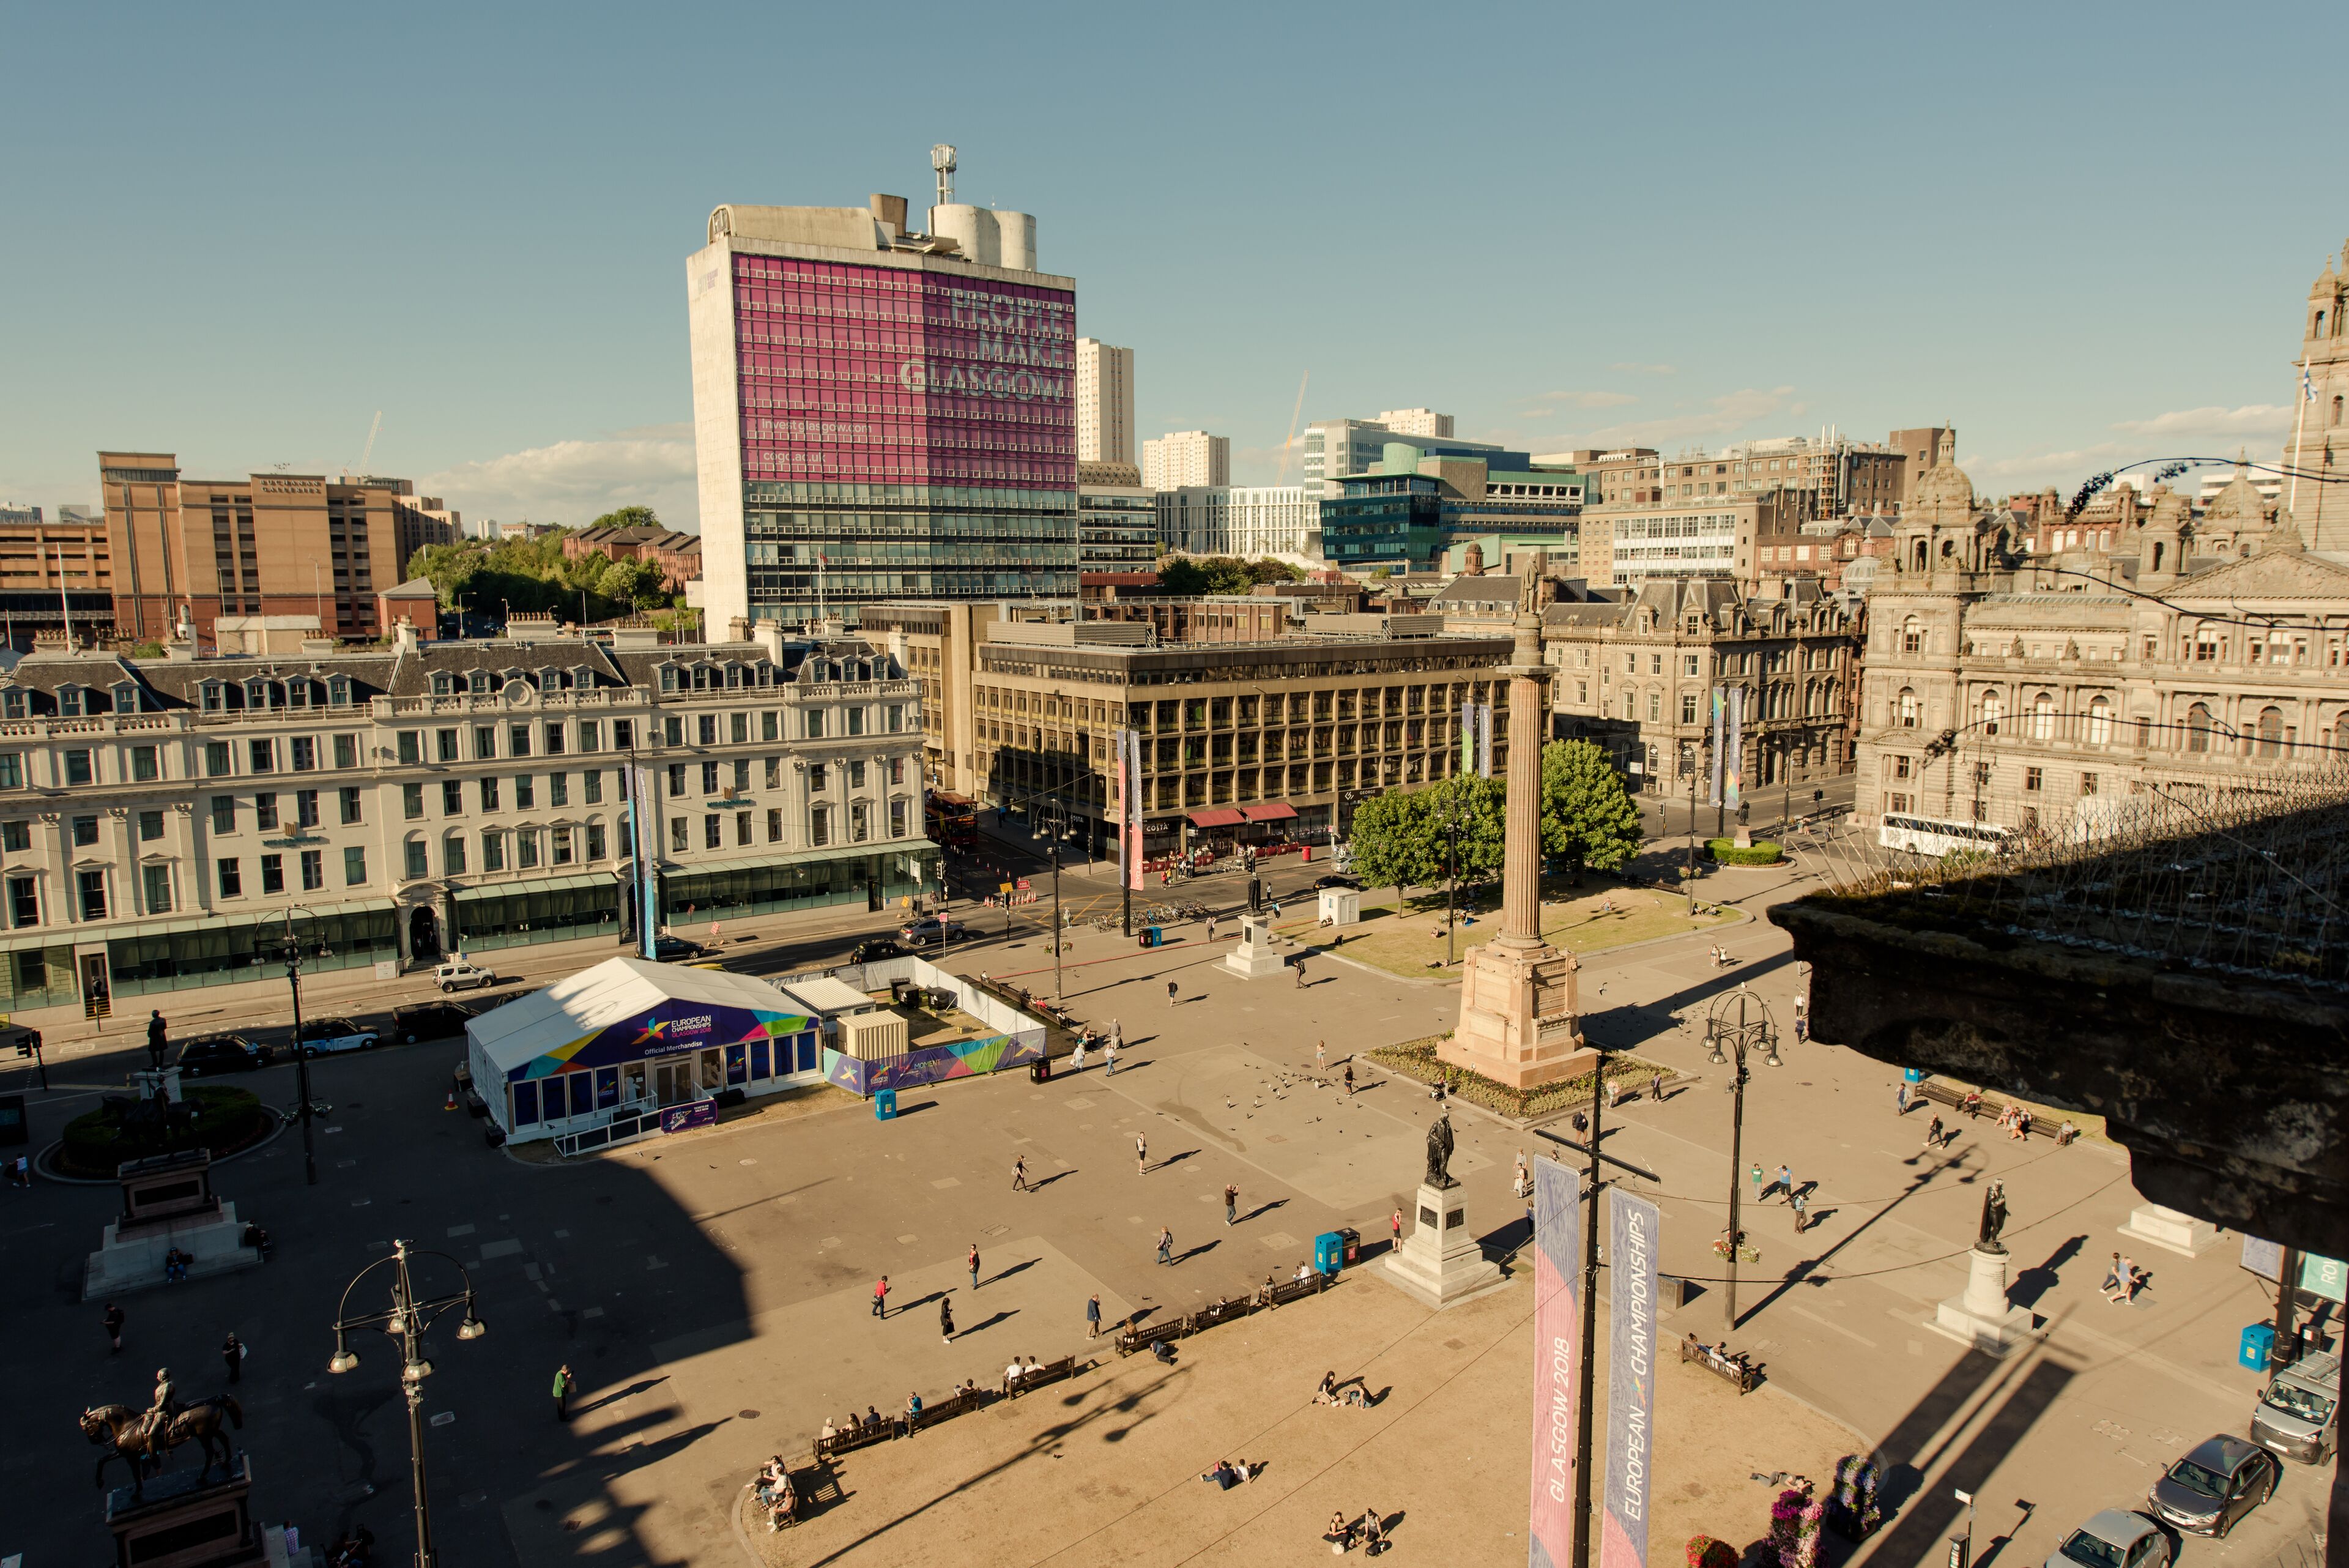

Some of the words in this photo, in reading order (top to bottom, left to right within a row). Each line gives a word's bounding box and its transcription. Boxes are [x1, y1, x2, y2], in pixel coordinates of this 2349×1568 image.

[952, 288, 1064, 334] PEOPLE
[979, 329, 1065, 368] MAKE
[900, 359, 1065, 403] GLASGOW
[763, 451, 826, 463] cogc.ac.uk
[1146, 823, 1169, 831] COSTA
[672, 1015, 711, 1028] EUROPEAN
[672, 1022, 711, 1033] CHAMPIONSHIPS
[667, 1041, 703, 1052] Merchandise
[1628, 1209, 1647, 1376] CHAMPIONSHIPS
[1554, 1337, 1570, 1386] 2018
[1551, 1388, 1570, 1503] GLASGOW
[1625, 1405, 1647, 1520] EUROPEAN
